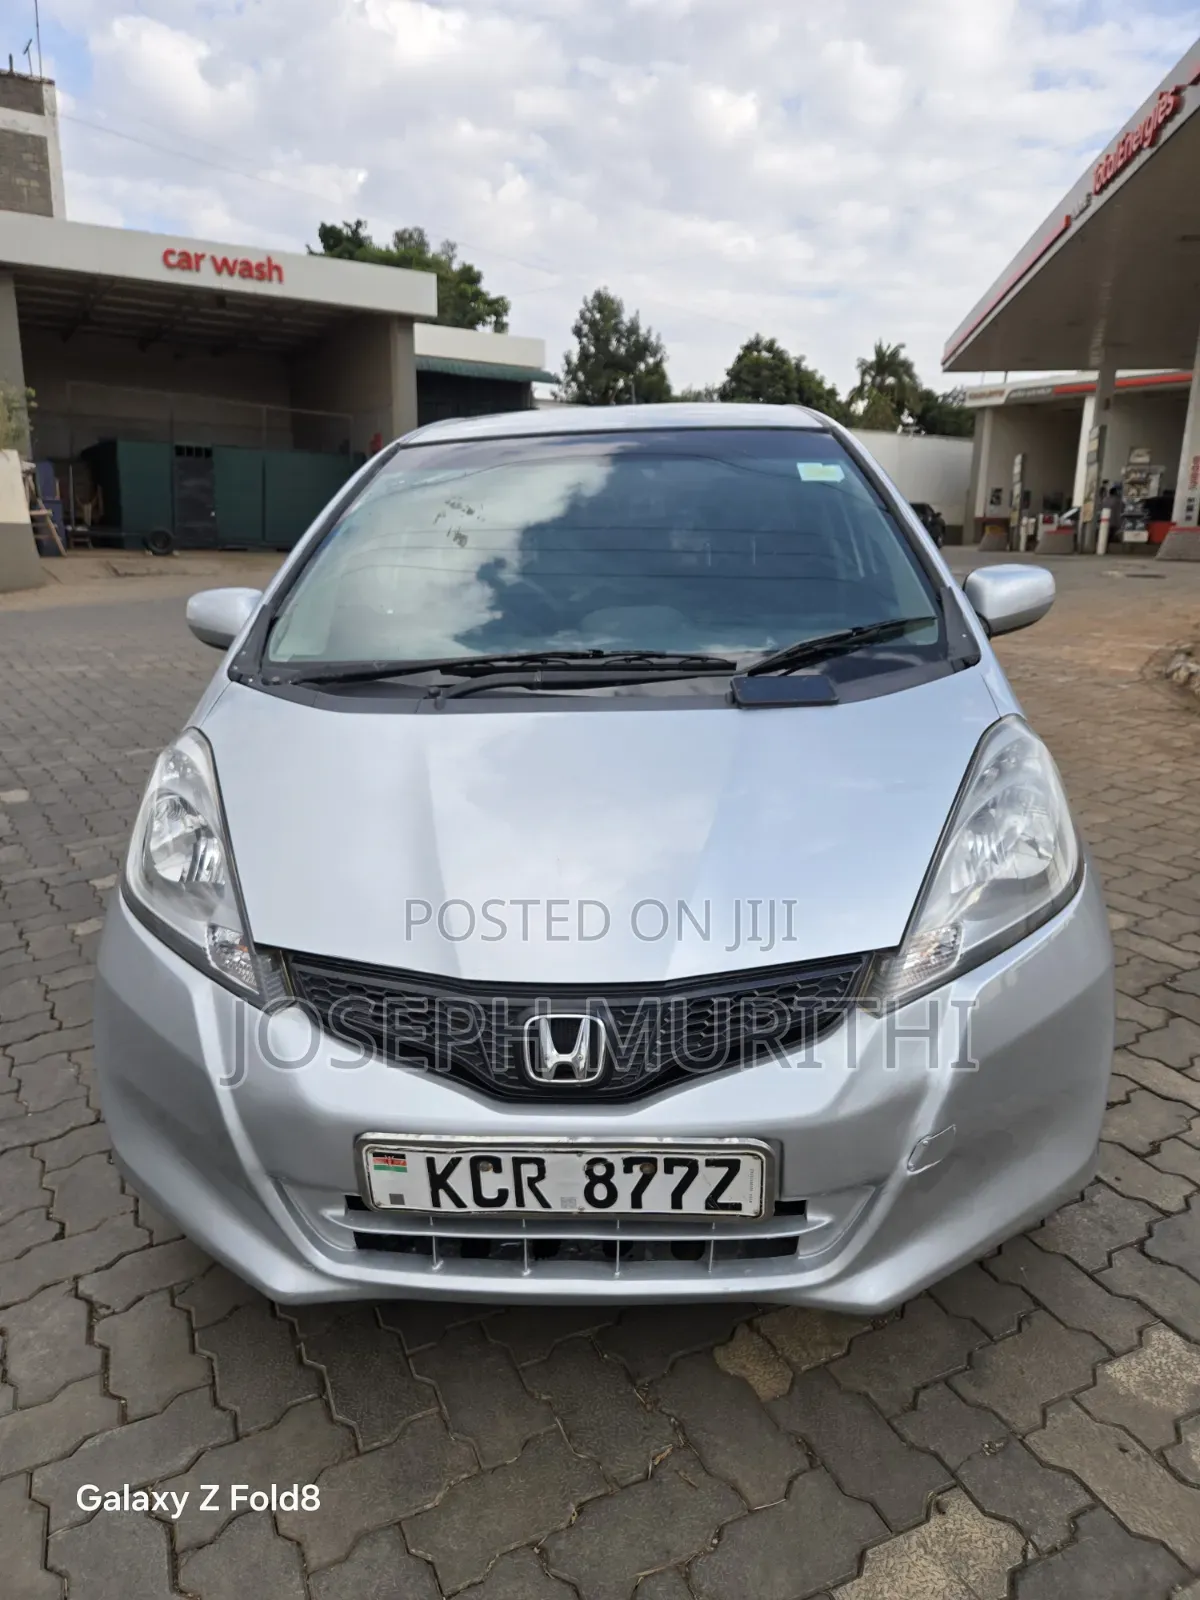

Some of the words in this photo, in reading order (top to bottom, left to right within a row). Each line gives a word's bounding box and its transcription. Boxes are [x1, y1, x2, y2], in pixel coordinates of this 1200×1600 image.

[162, 248, 206, 272] car
[210, 255, 284, 284] wash
[425, 1155, 552, 1209] KCR
[583, 1157, 742, 1211] 877Z
